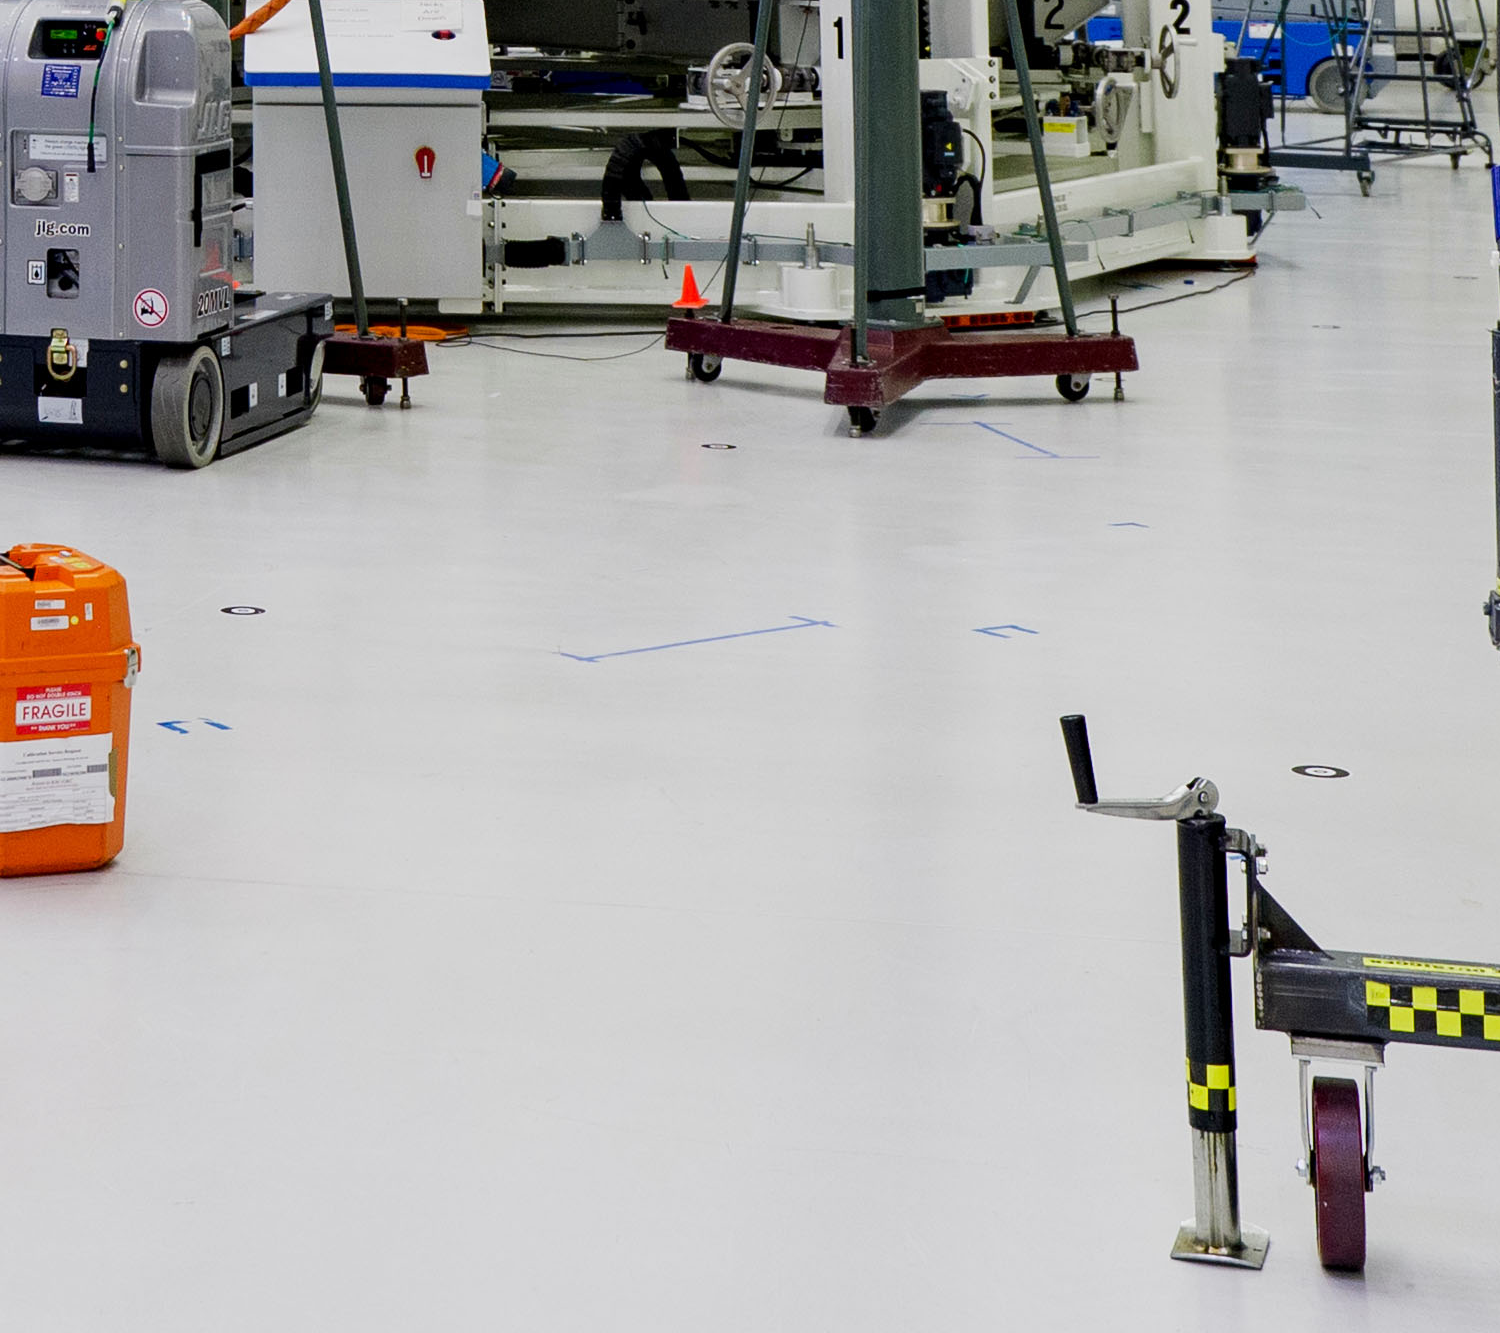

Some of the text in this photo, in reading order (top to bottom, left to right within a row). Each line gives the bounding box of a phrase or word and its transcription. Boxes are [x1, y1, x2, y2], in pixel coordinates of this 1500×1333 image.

[832, 15, 845, 60] 1
[34, 219, 92, 237] jlg.com
[197, 286, 230, 318] 20MVL
[22, 702, 87, 721] FRAGILE
